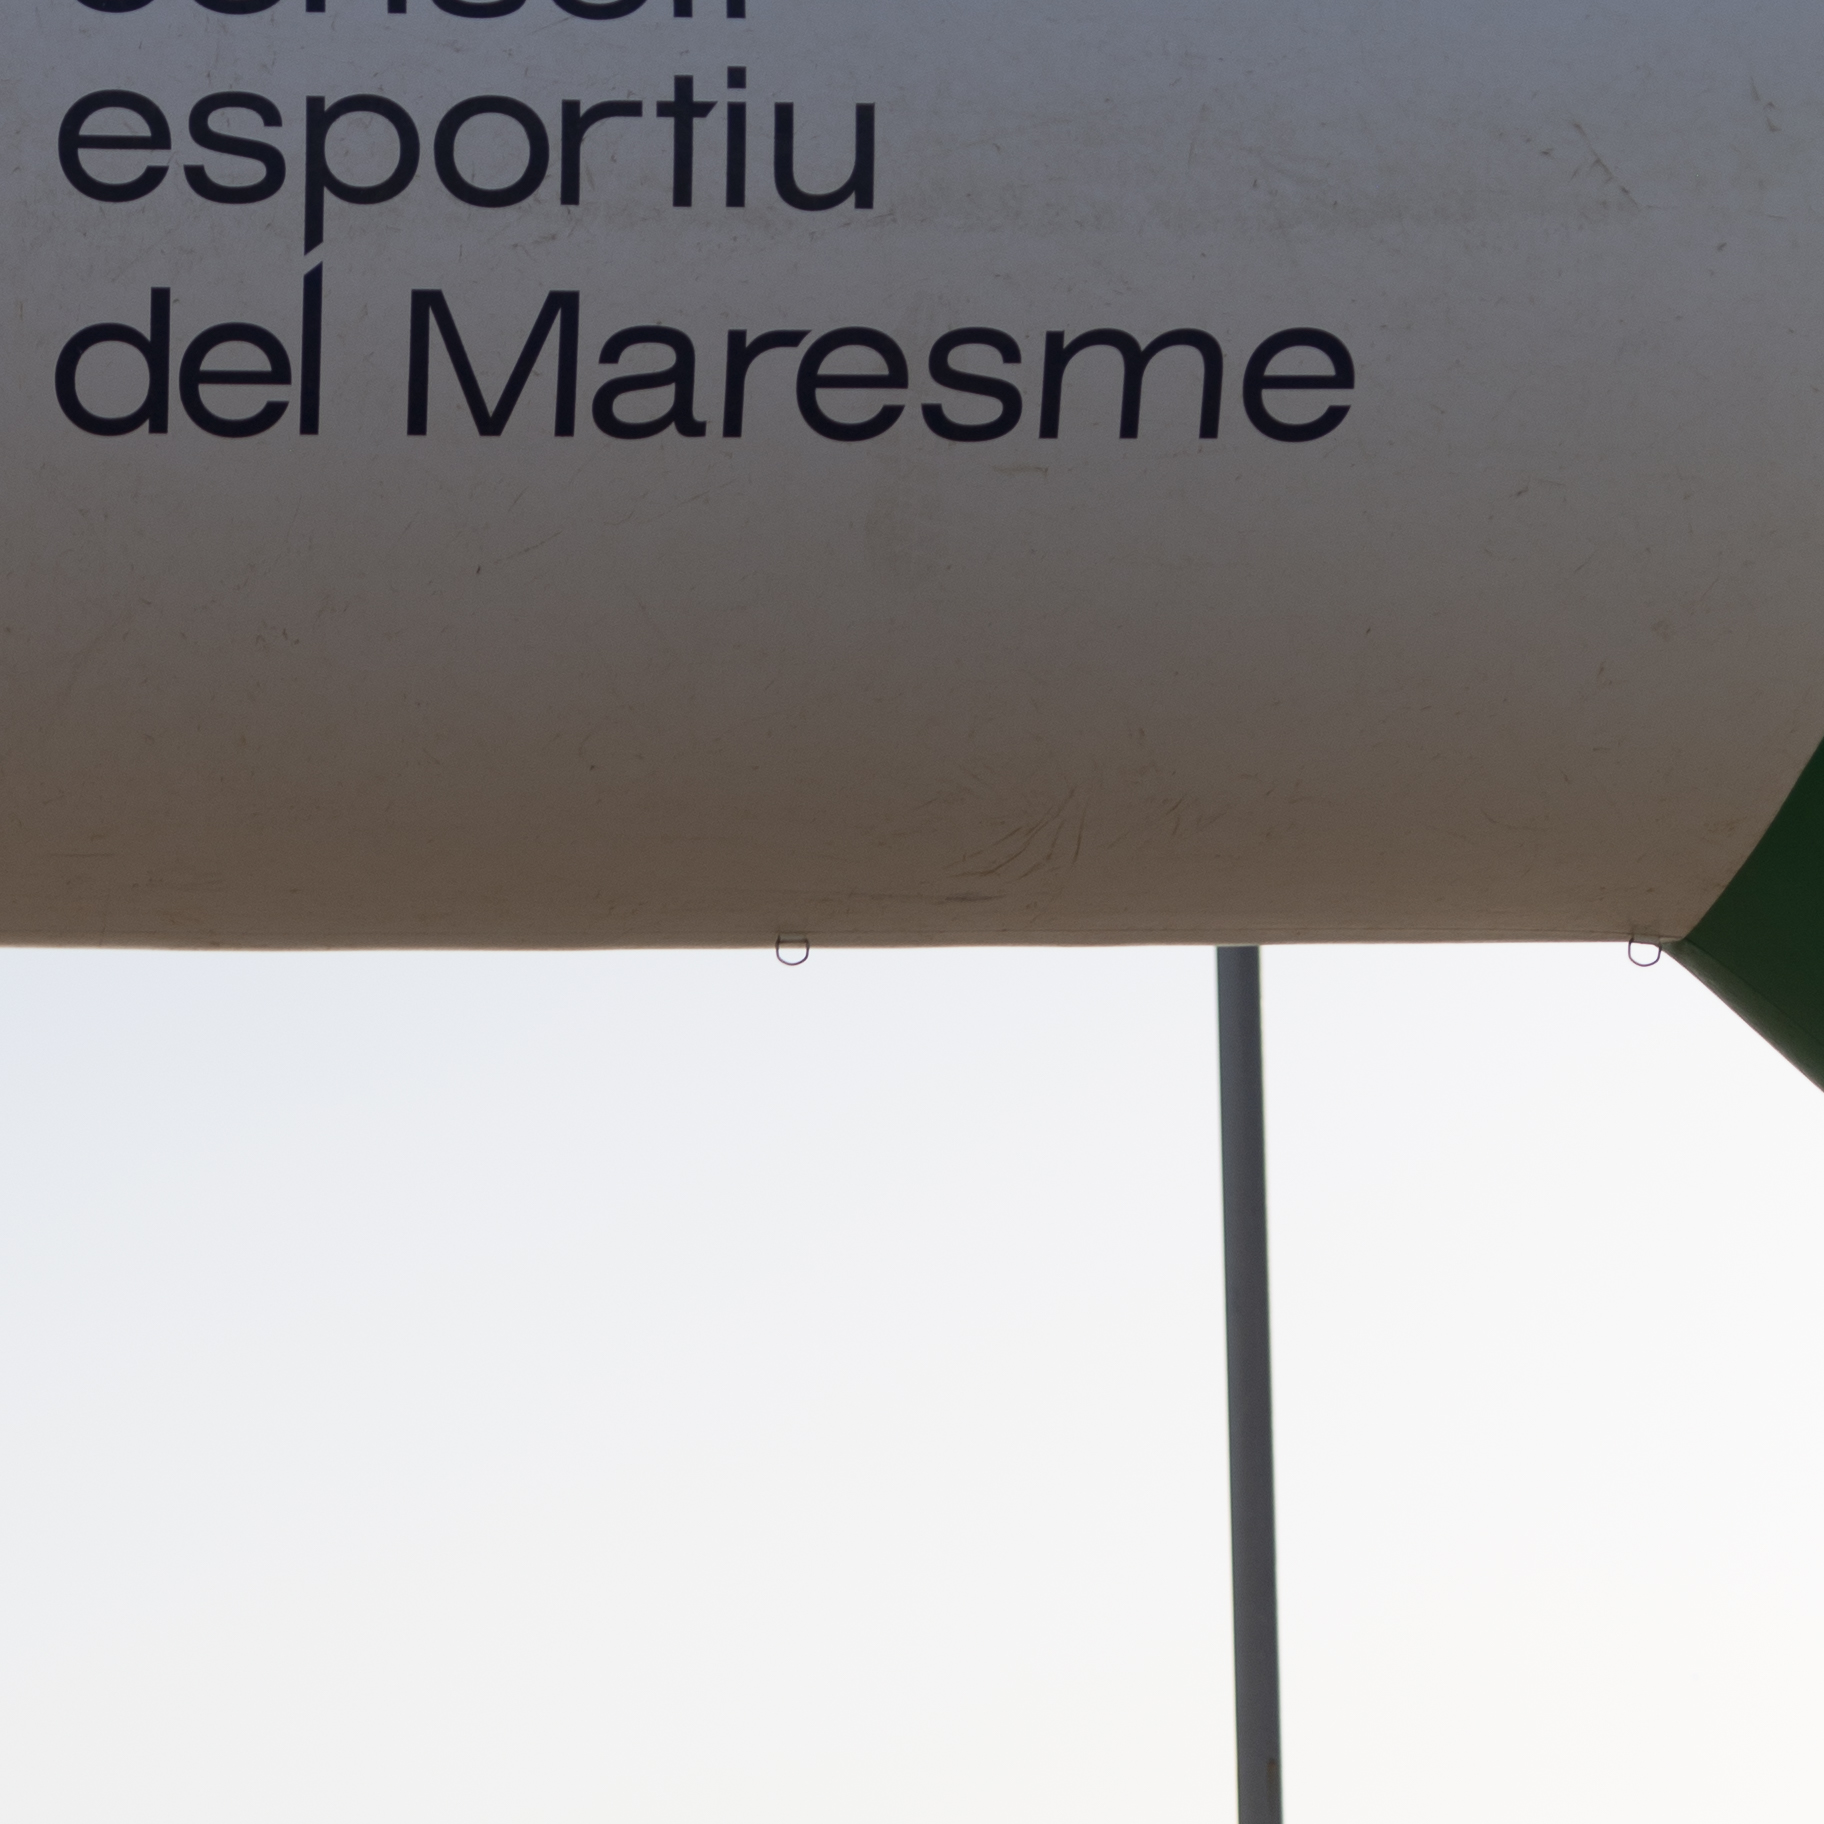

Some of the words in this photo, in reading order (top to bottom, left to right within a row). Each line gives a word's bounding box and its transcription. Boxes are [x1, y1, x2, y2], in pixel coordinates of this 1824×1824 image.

[55, 66, 878, 256] esportiu
[53, 260, 324, 438] del
[405, 287, 1357, 443] Maresme
